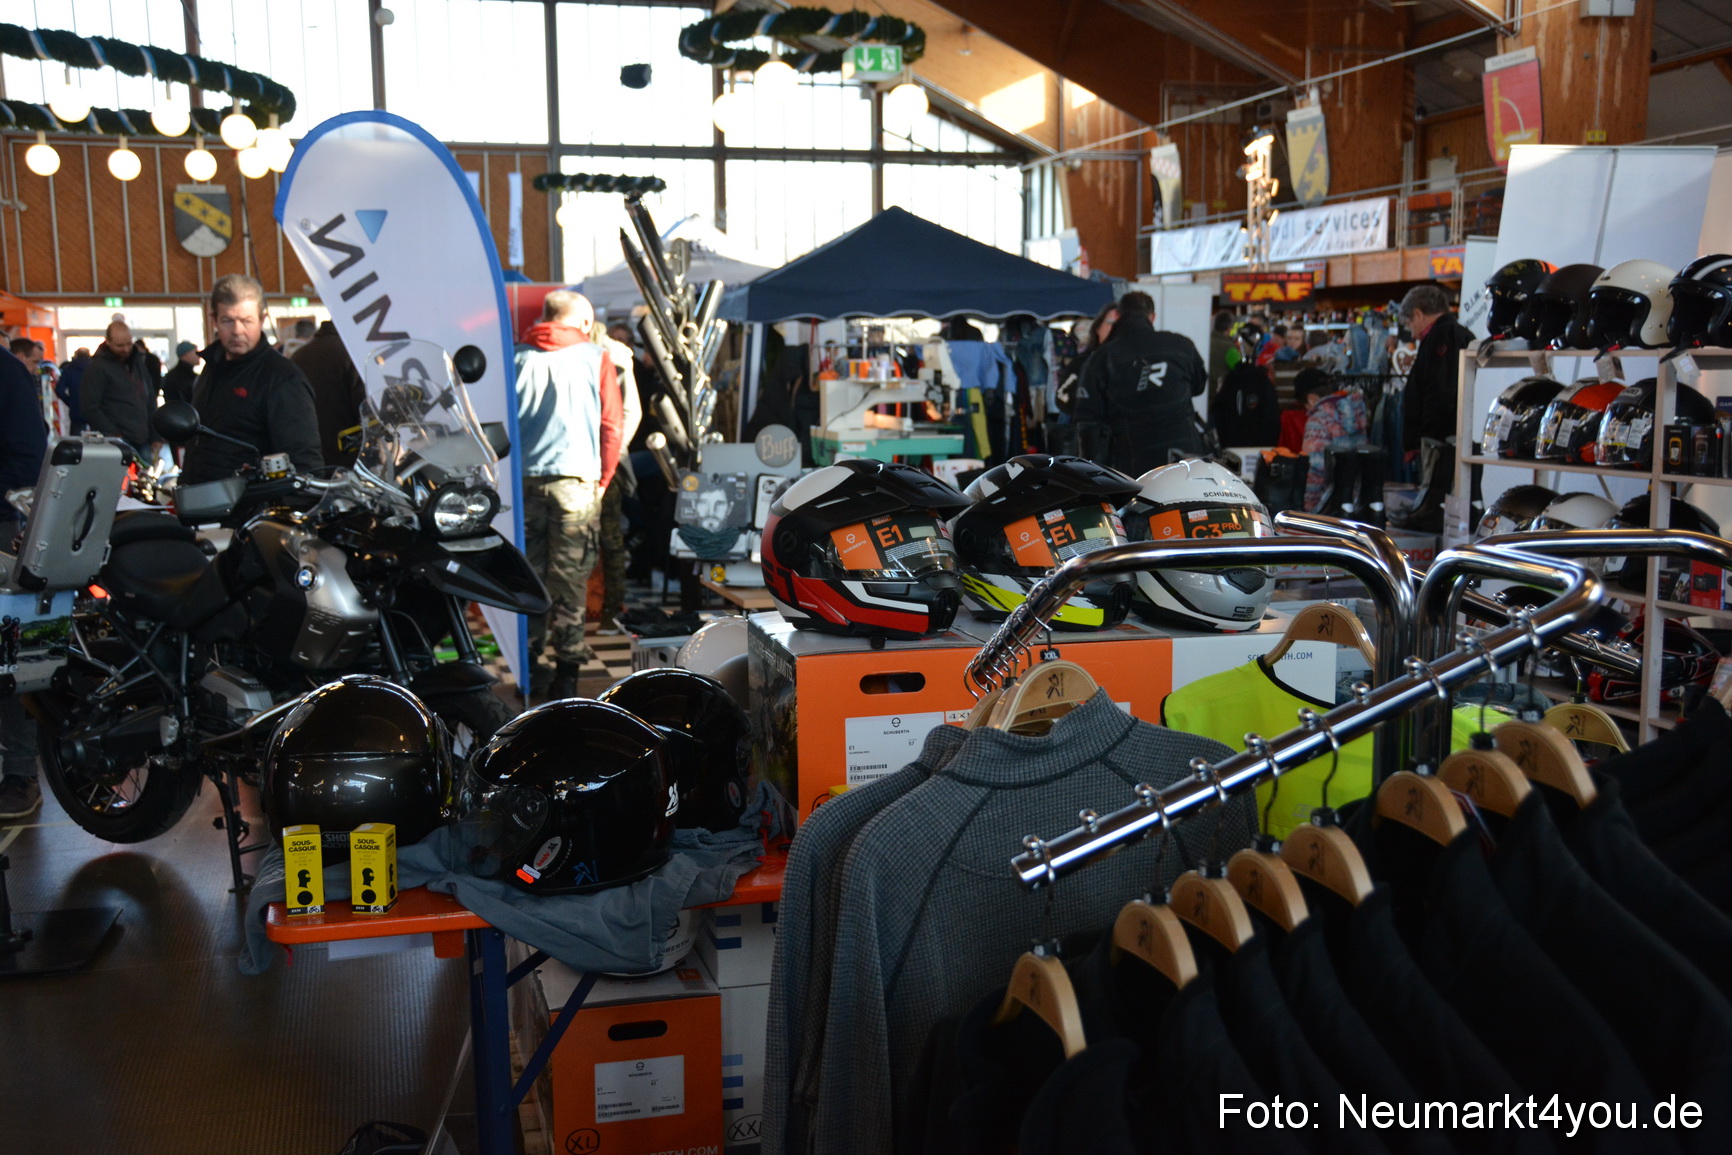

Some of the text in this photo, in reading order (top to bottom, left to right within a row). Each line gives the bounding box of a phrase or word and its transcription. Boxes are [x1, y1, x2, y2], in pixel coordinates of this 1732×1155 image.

[1305, 209, 1380, 235] services
[1223, 282, 1313, 302] TAF
[1203, 491, 1248, 500] SCHUBERTH
[876, 524, 904, 548] E1
[1049, 523, 1077, 546] E1
[1192, 522, 1242, 539] C3 PRO
[1044, 651, 1058, 660] XXL
[289, 845, 317, 853] CASQUE
